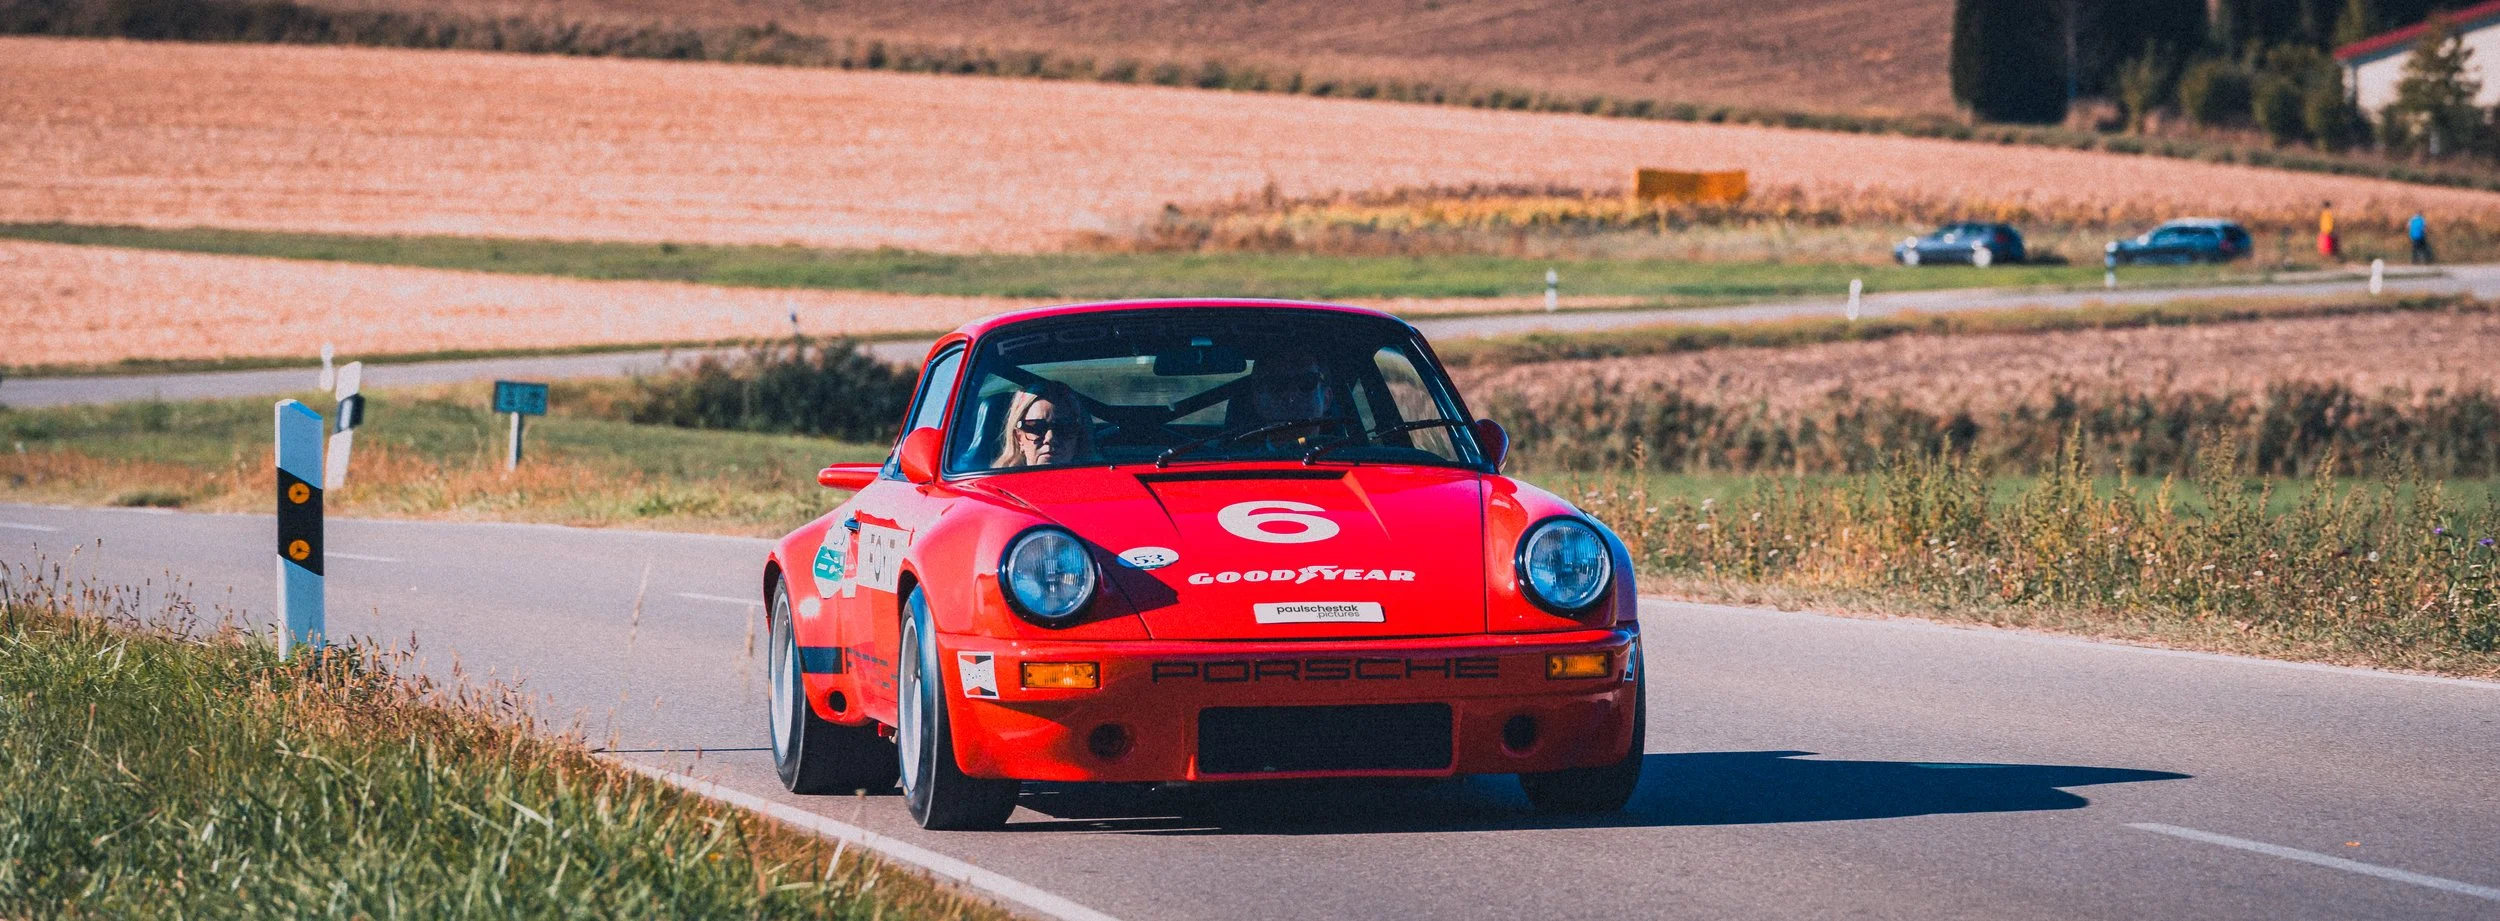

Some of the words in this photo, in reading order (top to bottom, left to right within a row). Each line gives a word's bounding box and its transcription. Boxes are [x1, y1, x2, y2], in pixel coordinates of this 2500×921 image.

[1217, 500, 1341, 544] 6
[1133, 554, 1165, 565] 53
[1188, 565, 1416, 585] GOODYEAR
[1276, 604, 1358, 614] paulschestak
[1152, 657, 1500, 683] PORSCHE
